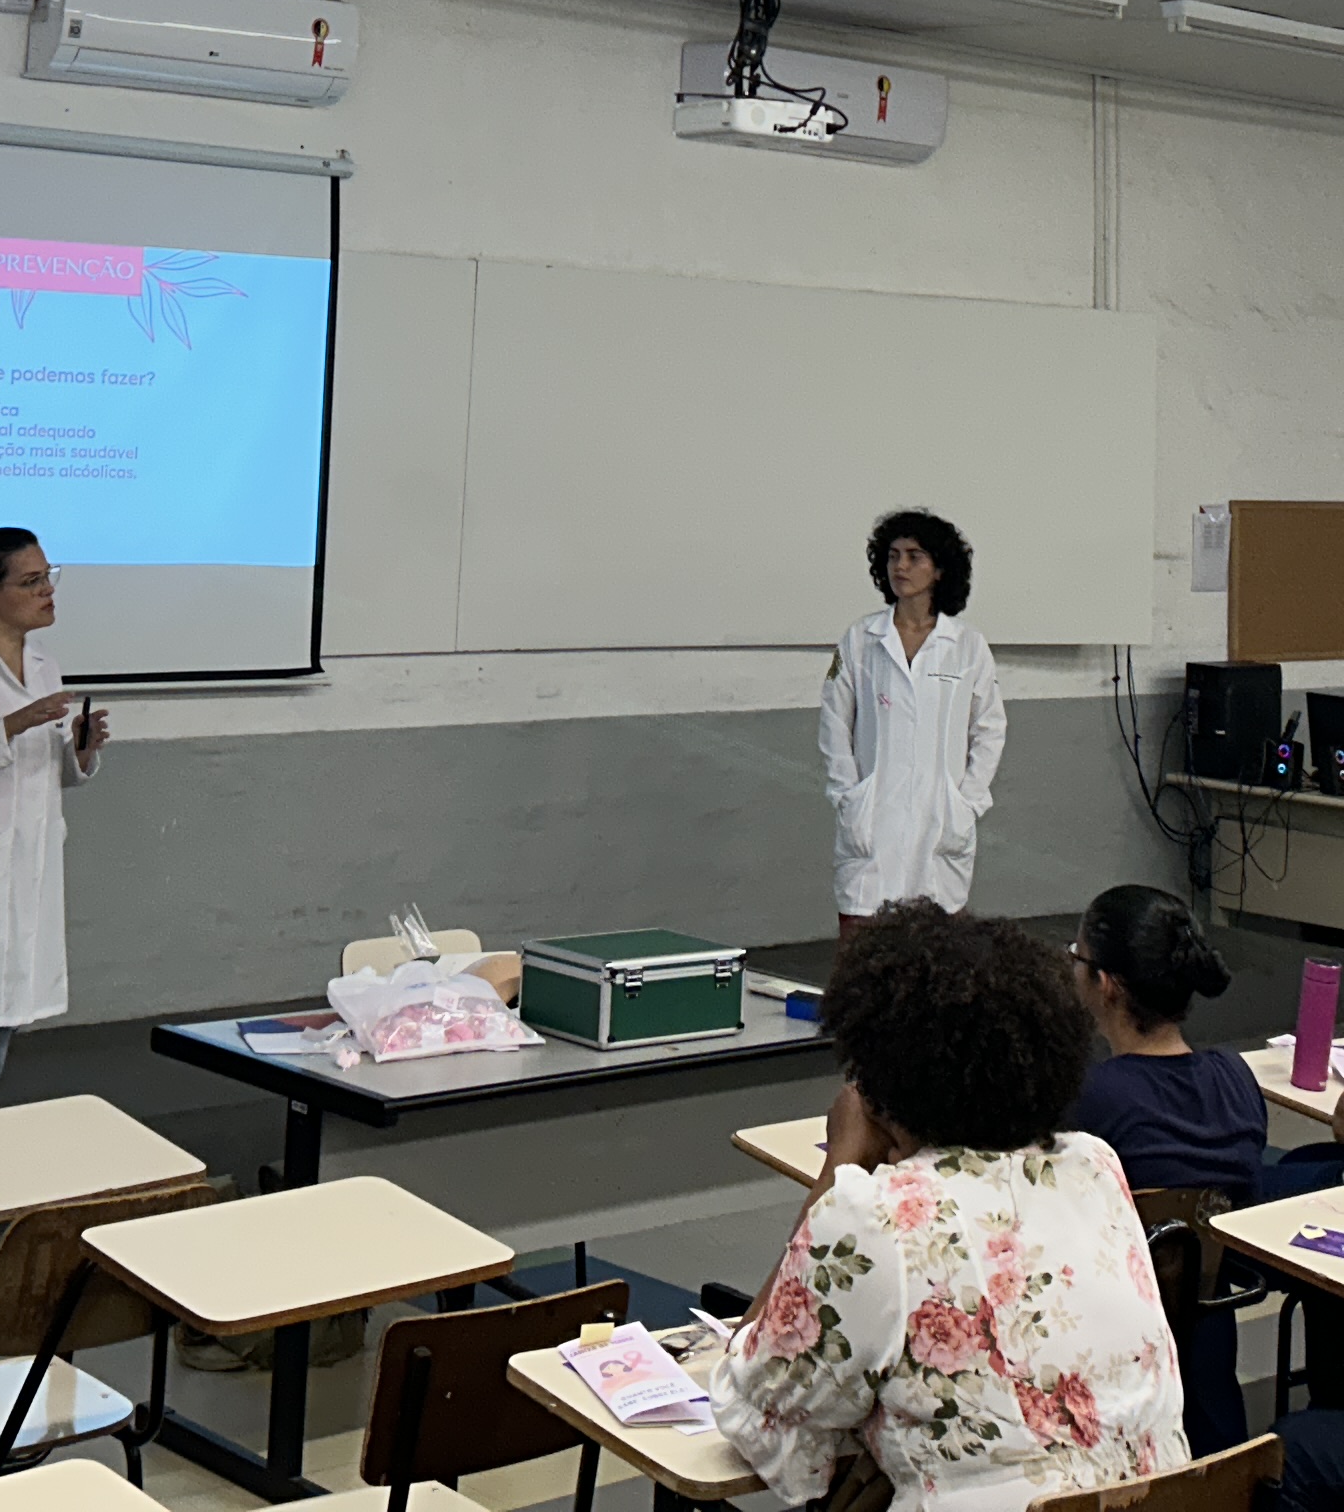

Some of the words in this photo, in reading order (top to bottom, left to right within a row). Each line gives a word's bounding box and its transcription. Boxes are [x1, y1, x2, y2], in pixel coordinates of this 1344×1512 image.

[10, 366, 96, 385] podemos
[100, 369, 156, 386] fazer?
[17, 424, 96, 440] adequado
[29, 444, 66, 458] mais
[70, 445, 139, 460] saudável
